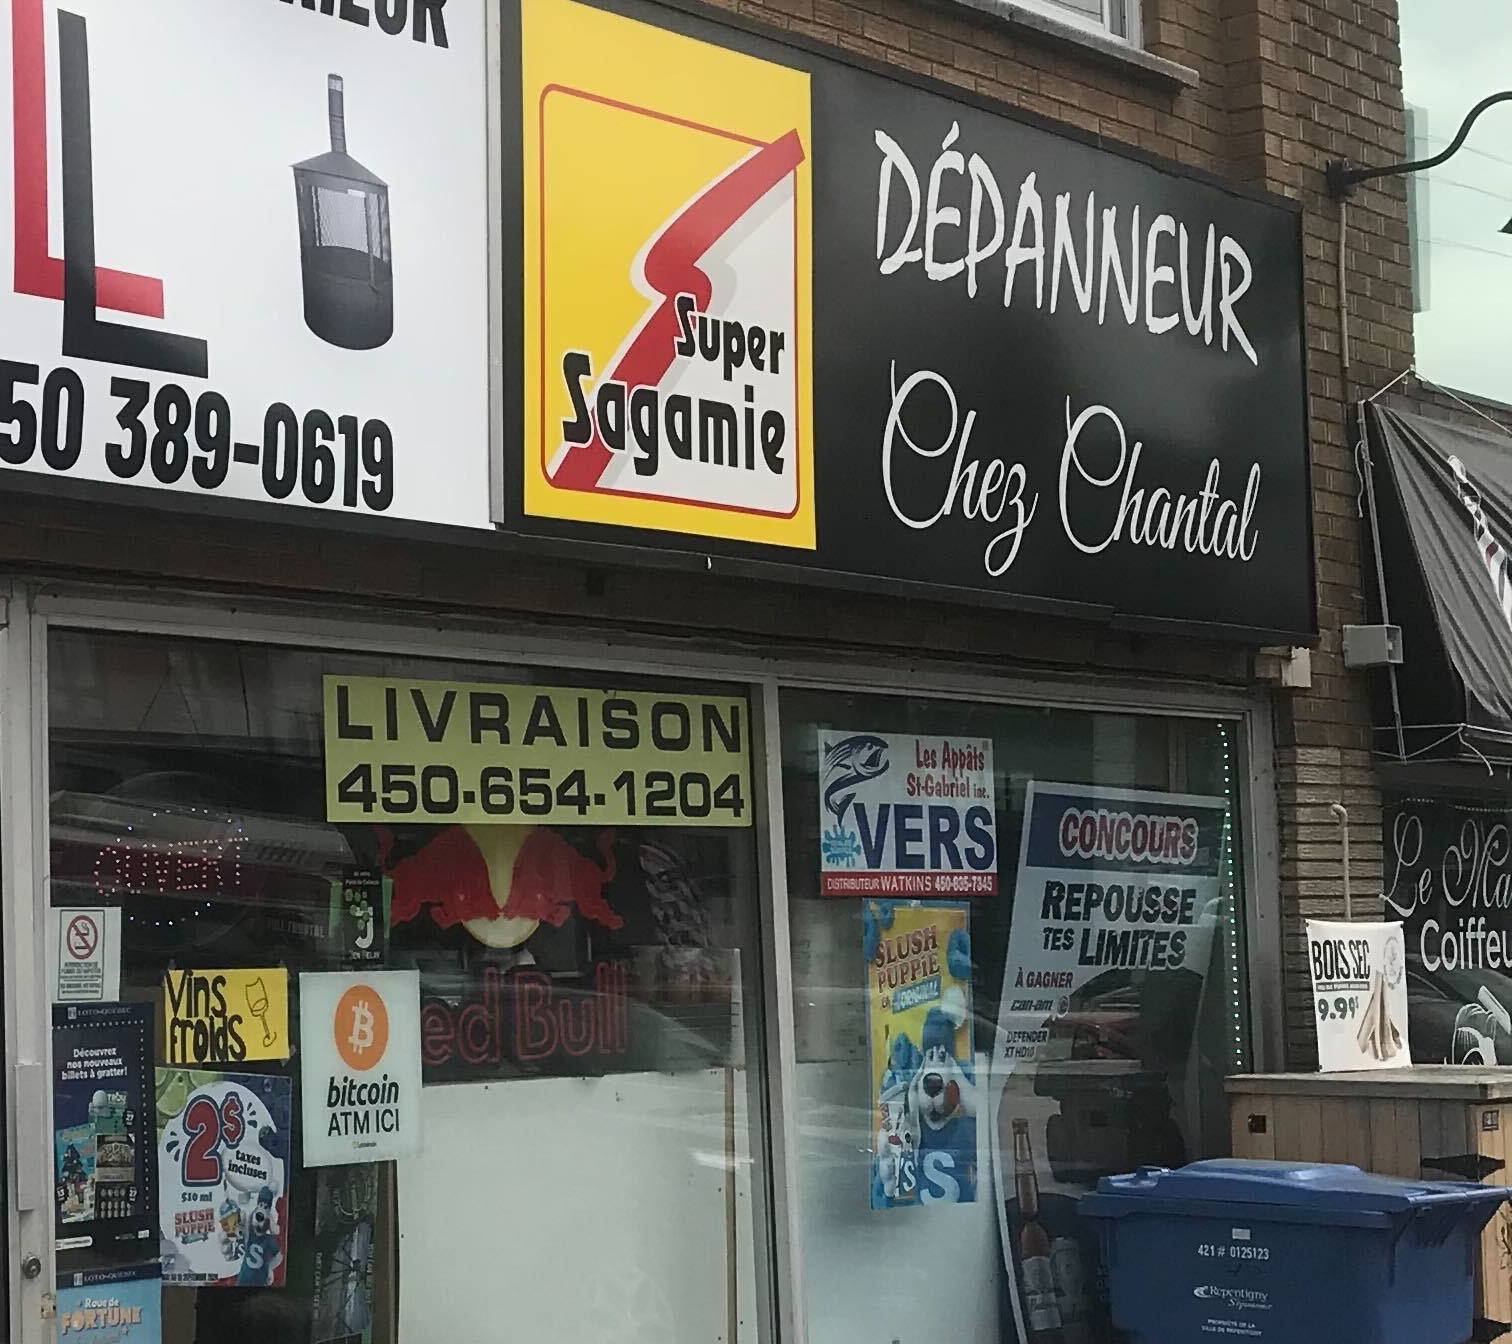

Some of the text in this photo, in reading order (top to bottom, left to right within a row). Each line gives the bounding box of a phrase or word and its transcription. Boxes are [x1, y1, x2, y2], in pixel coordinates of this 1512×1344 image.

[875, 120, 1258, 366] DÉPANNEUR
[676, 296, 785, 376] Super
[562, 351, 786, 476] Sagamie
[105, 375, 394, 512] 389-0619
[883, 360, 1263, 577] Chez Chantal
[337, 685, 742, 754] LIVRAISON
[916, 739, 984, 777] Les Appâts
[907, 773, 970, 799] St-Gabriel
[853, 803, 994, 870] VERS
[1060, 809, 1198, 864] CONCOURS
[1379, 812, 1433, 917] Le
[828, 877, 880, 891] DISTRIBUTEUR
[881, 876, 932, 891] WATKINS
[1041, 880, 1195, 924] REPOUSSE
[876, 925, 937, 968] SLUSH
[1043, 926, 1187, 969] TES LIMITES
[1311, 939, 1370, 980] BOIS SEC
[877, 956, 940, 993] PUPPIE
[1015, 967, 1073, 988] À GAGNER
[165, 969, 227, 1018] Vins
[513, 960, 630, 1062] Bull
[73, 1047, 117, 1058] Découvrez
[1006, 1030, 1048, 1043] DEFENDER
[62, 1067, 128, 1080] billets à gratter!
[67, 1058, 123, 1069] nos nouveaux
[327, 1074, 399, 1108] bitcoin
[327, 1108, 400, 1136] ATM ICI
[228, 1162, 267, 1180] incluses
[236, 1150, 261, 1165] taxes
[200, 1191, 212, 1202] ml
[175, 1208, 215, 1225] SLUSH
[175, 1222, 215, 1238] PUPPIE
[1198, 1245, 1214, 1256] 421
[1230, 1246, 1269, 1260] 0125123
[85, 1297, 120, 1308] Roue de
[1210, 1286, 1268, 1302] Repentigny
[62, 1307, 142, 1336] FORTUNE
